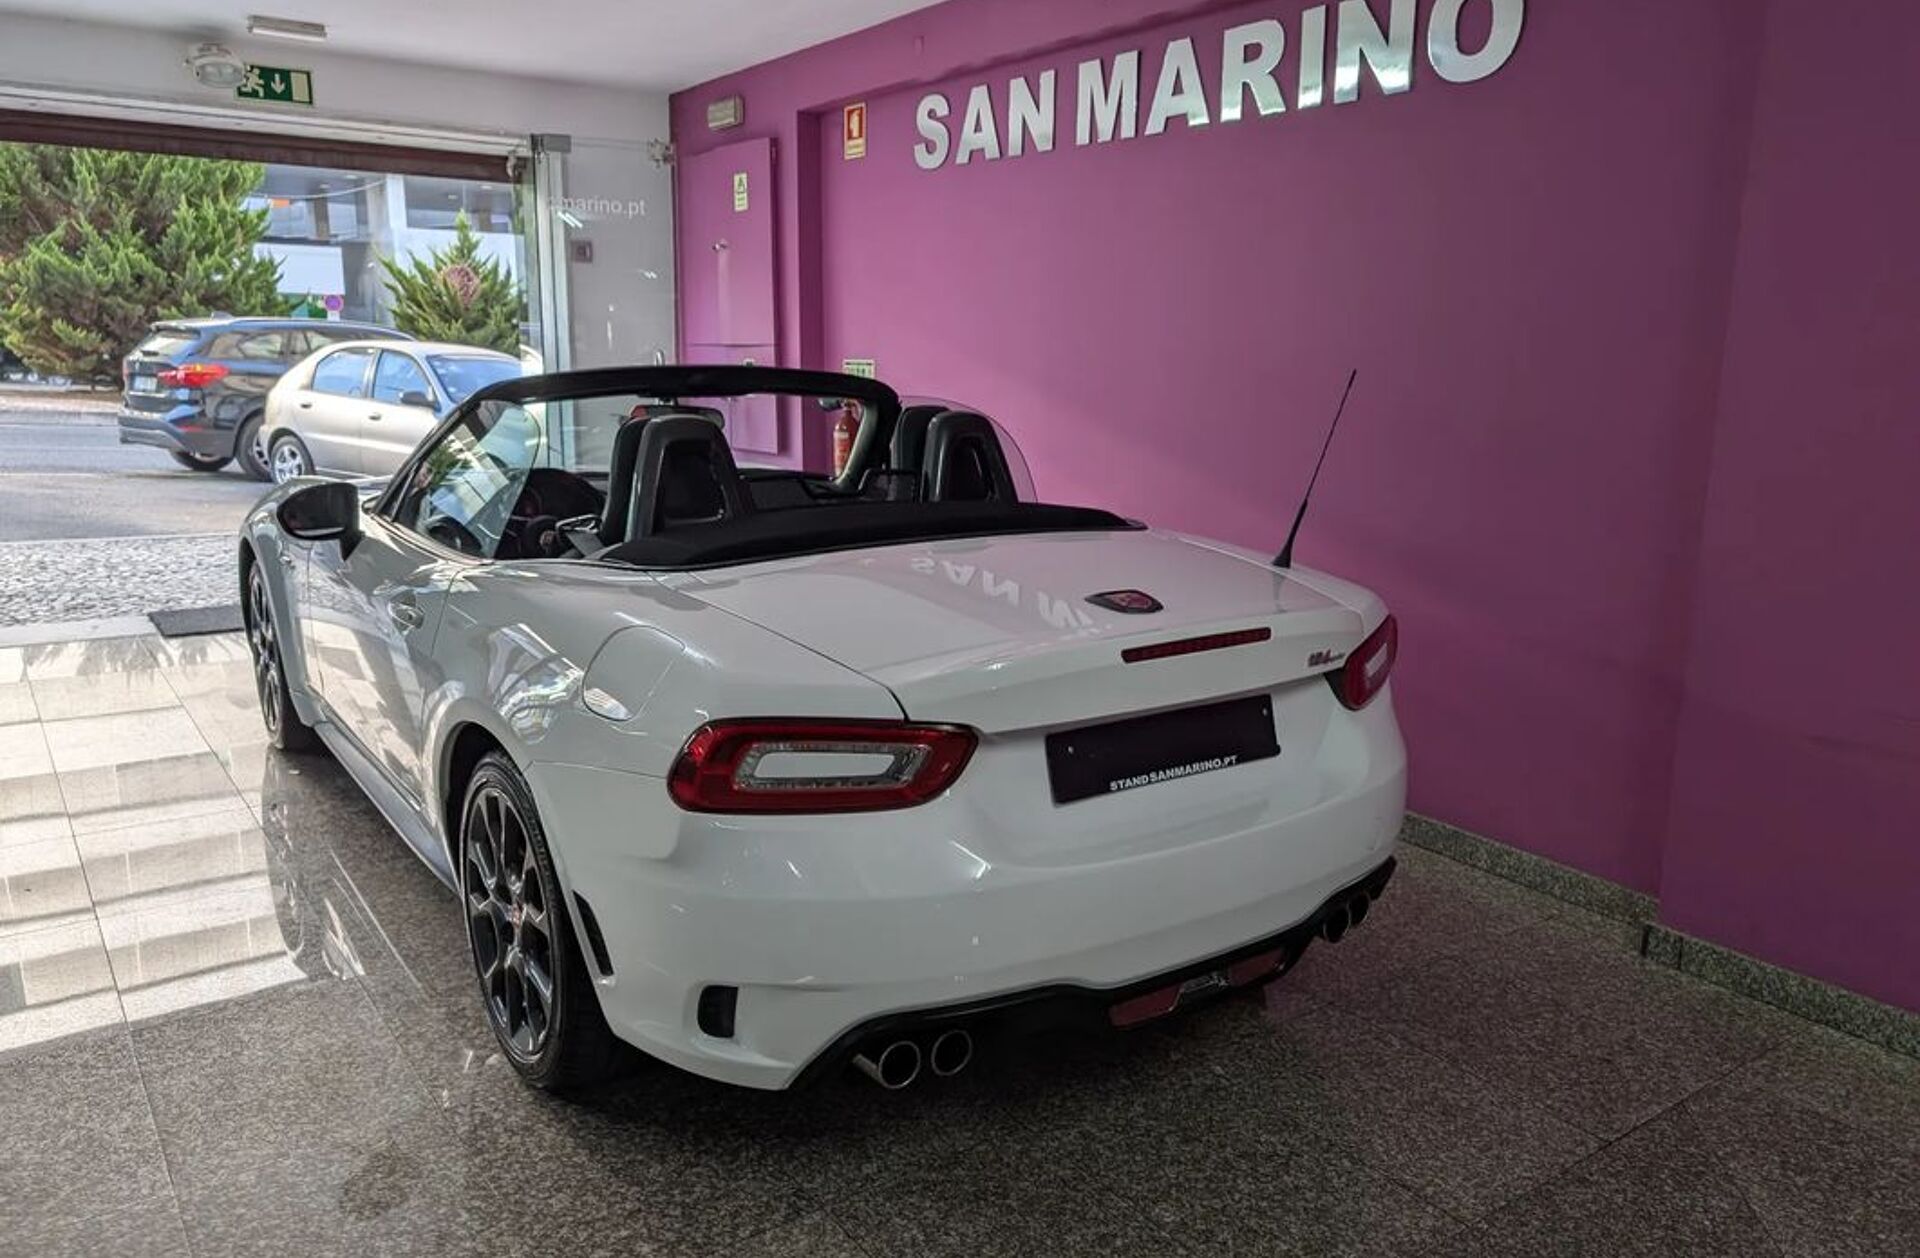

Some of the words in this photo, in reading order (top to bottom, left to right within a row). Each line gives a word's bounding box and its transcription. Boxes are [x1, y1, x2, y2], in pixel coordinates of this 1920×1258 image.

[913, 69, 1055, 171] SAN
[1075, 0, 1525, 146] MARINO
[1109, 754, 1238, 791] STANDSANMARINO.PT
